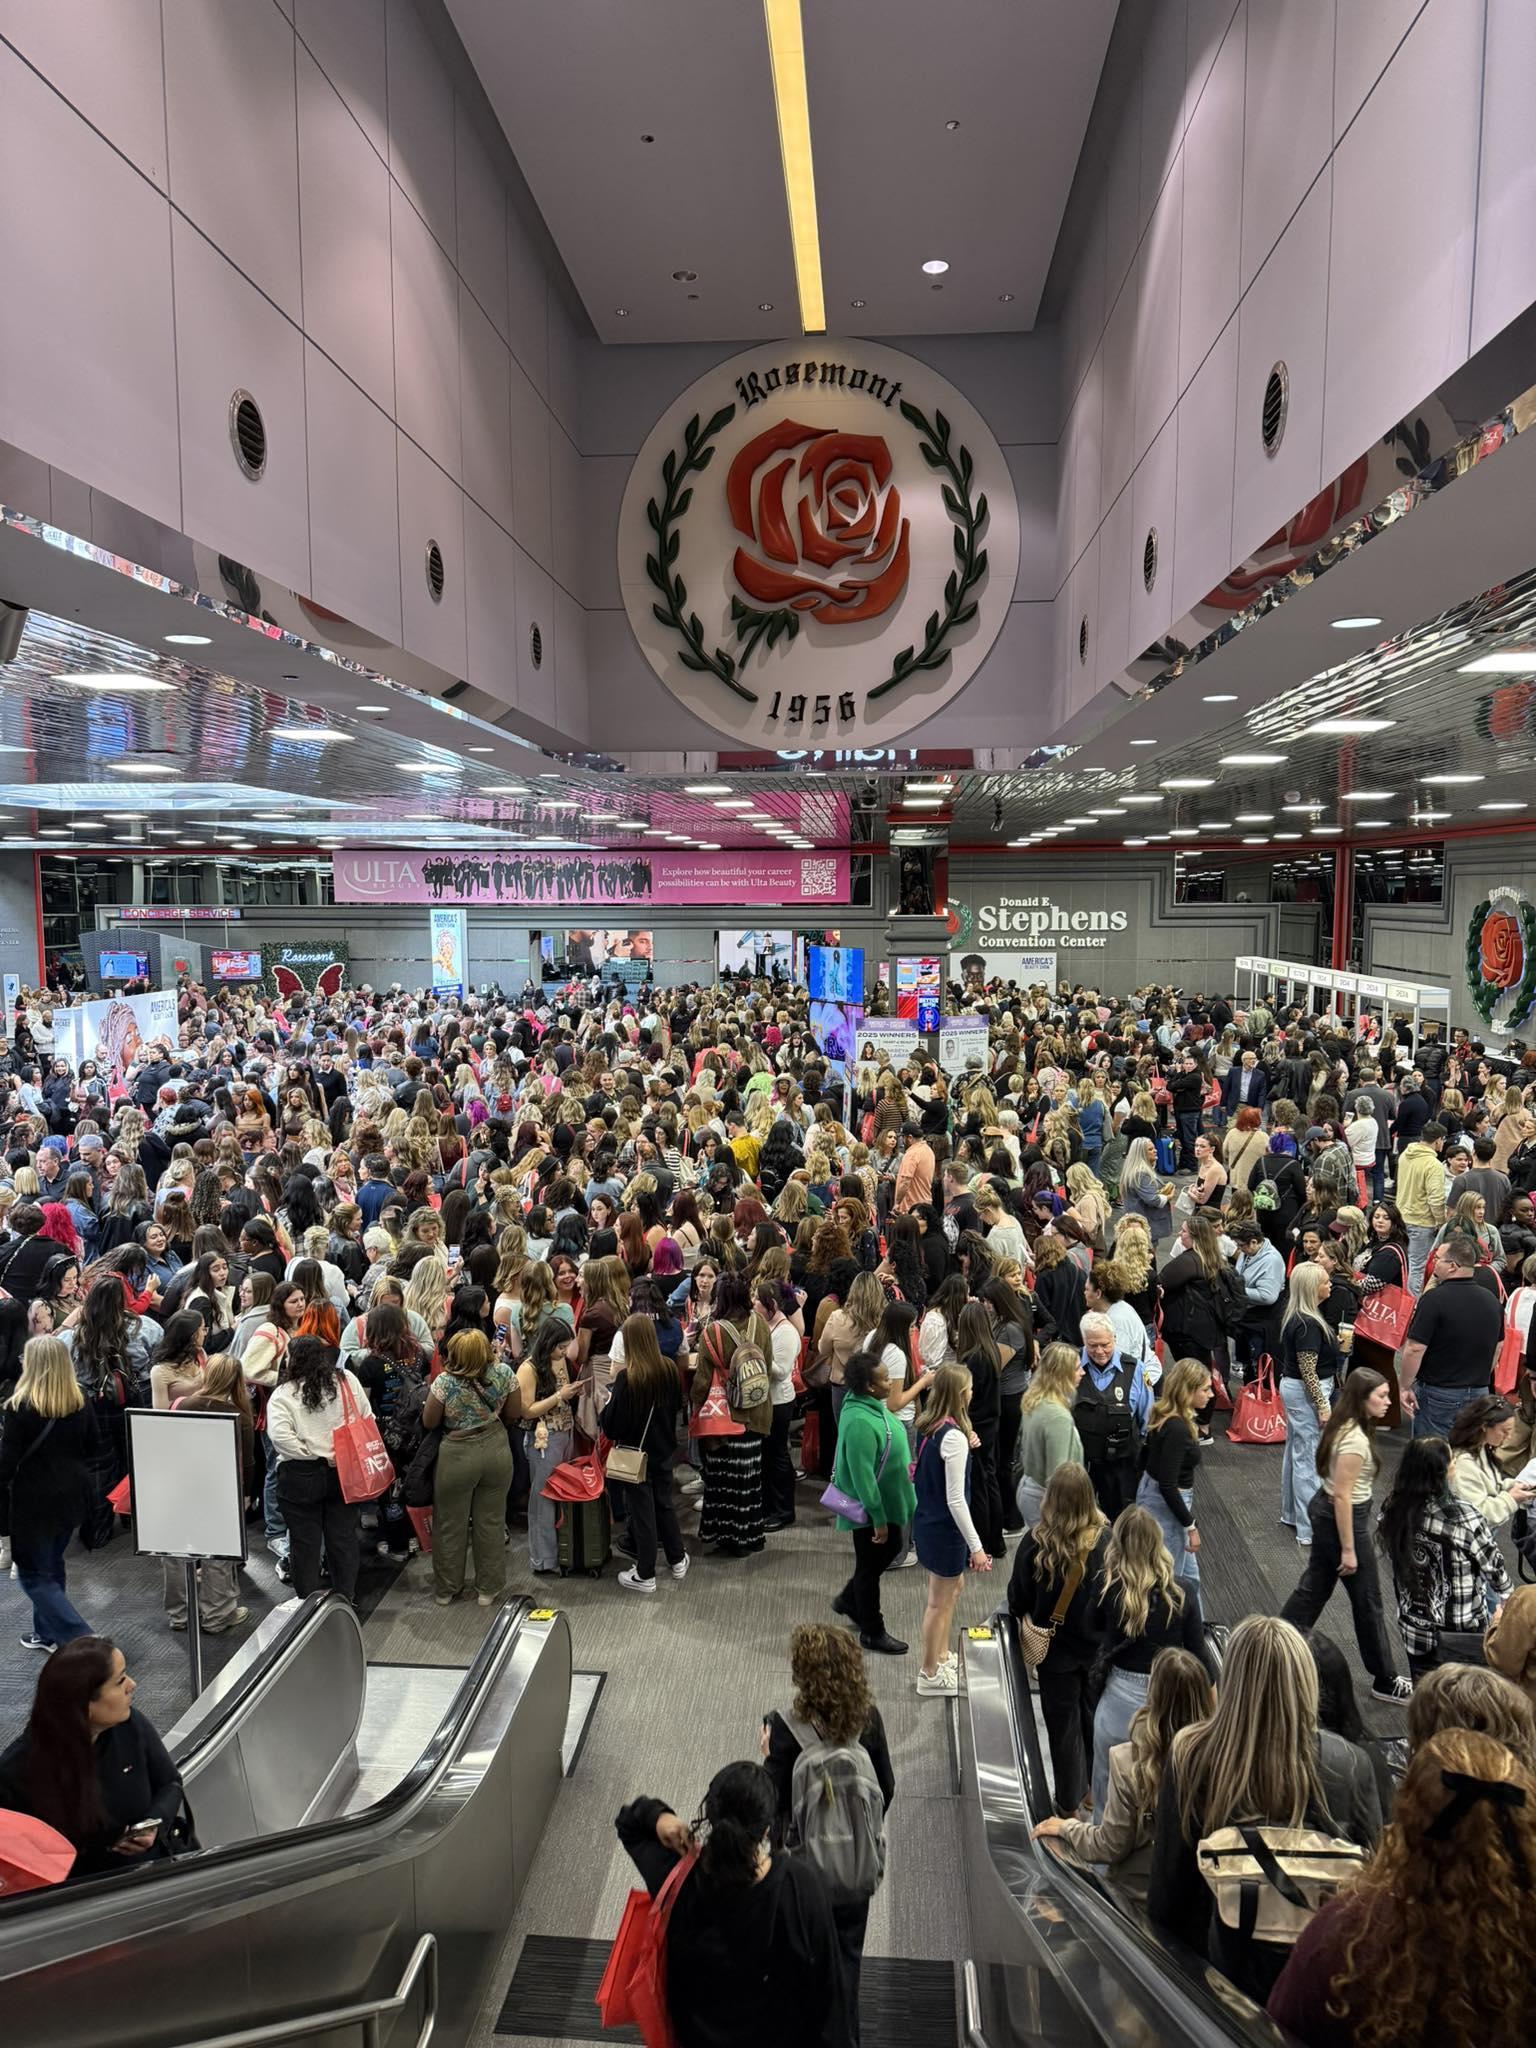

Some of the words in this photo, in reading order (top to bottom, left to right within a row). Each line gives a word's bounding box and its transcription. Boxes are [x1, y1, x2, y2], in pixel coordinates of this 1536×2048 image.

[735, 361, 903, 408] Rosemont
[768, 690, 856, 724] 1956
[353, 861, 417, 883] ULTA
[662, 867, 693, 877] Explore
[711, 867, 747, 875] beautiful
[748, 868, 766, 877] your
[658, 878, 704, 888] possibilities
[721, 878, 730, 886] be
[731, 878, 749, 886] with
[769, 878, 796, 888] Beauty
[1000, 897, 1039, 906] Donald
[1042, 897, 1053, 906] E.
[123, 908, 186, 918] CONCIERGE
[189, 908, 235, 918] SERVICE
[978, 906, 1128, 936] Stephens
[979, 936, 1056, 947] Convention
[1060, 936, 1107, 947] Center
[282, 949, 335, 962] Rosemont
